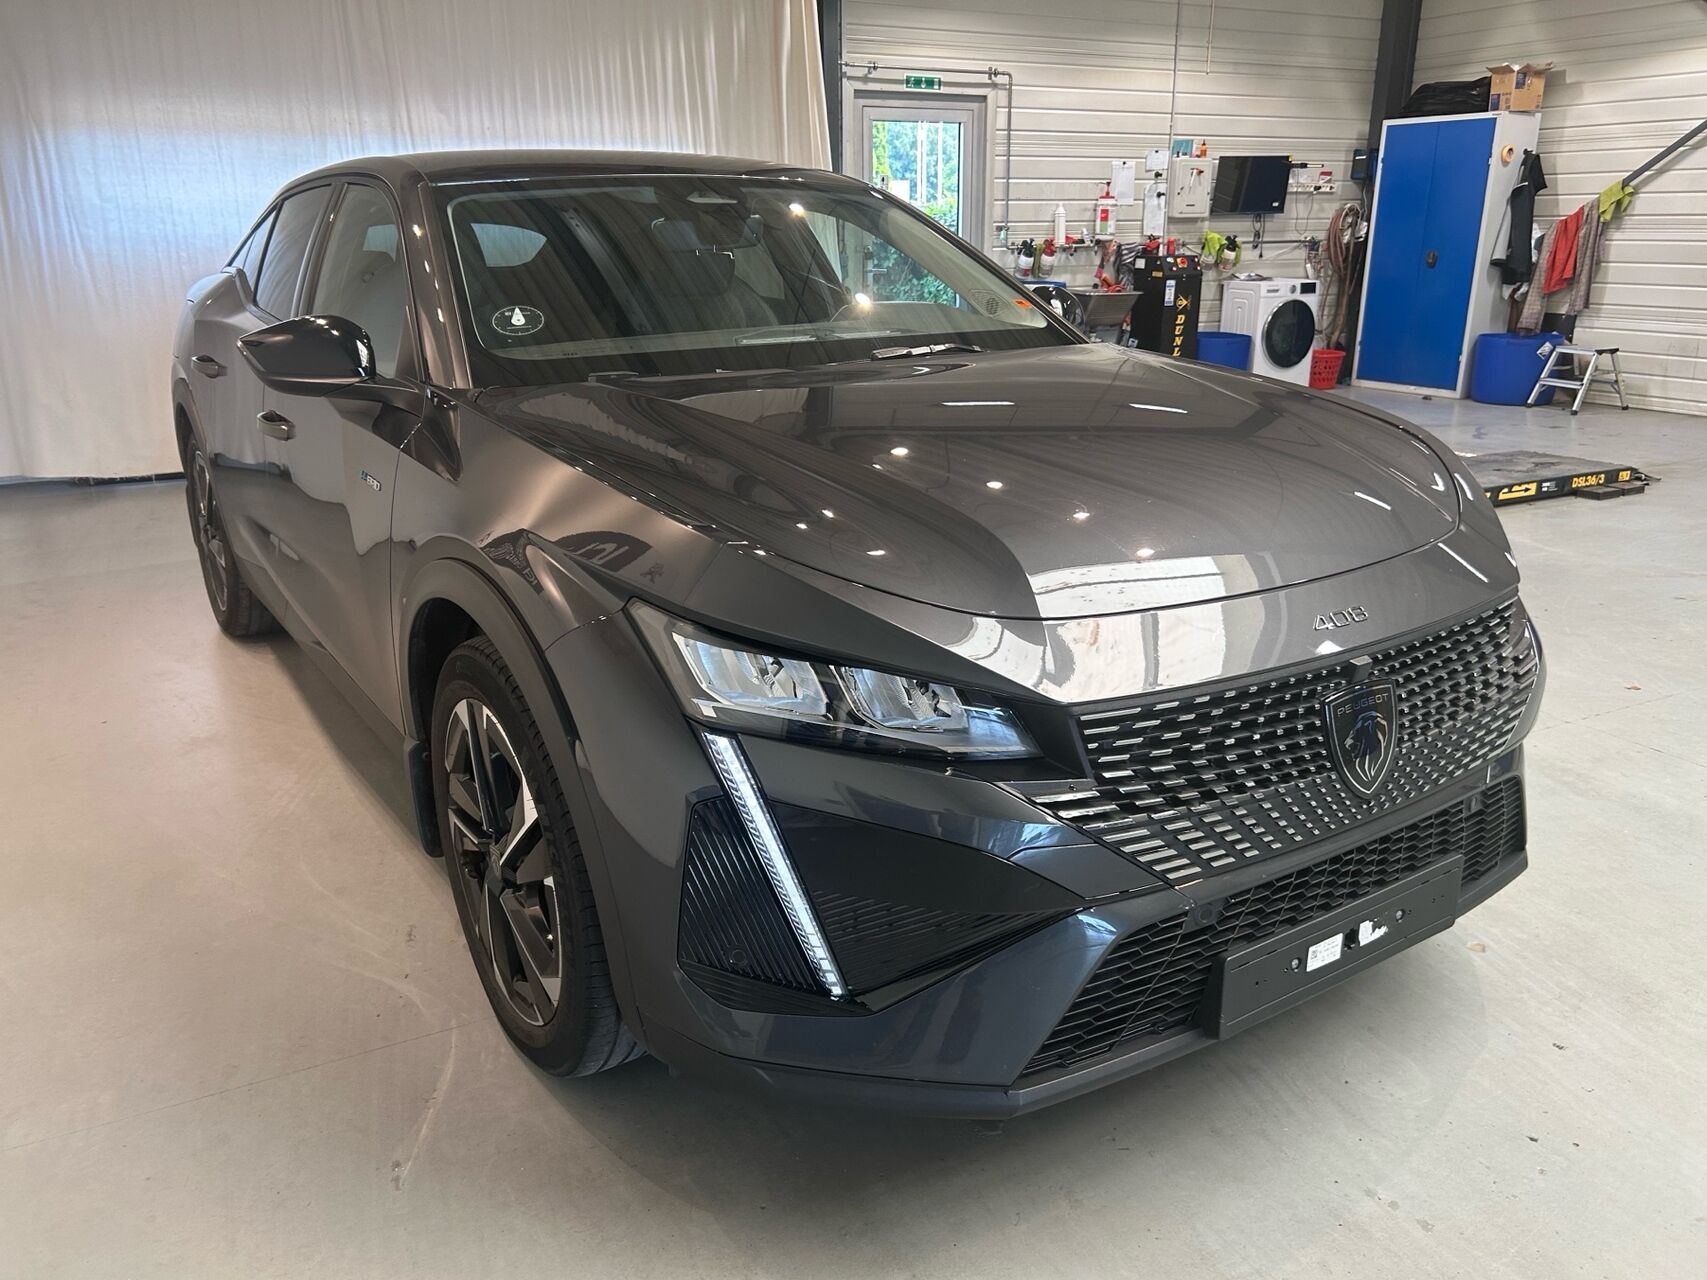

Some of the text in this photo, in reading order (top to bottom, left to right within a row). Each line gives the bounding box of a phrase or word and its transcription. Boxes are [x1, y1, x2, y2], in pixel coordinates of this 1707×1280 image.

[1571, 474, 1605, 488] DSL36/3
[1313, 606, 1368, 631] 408
[1337, 693, 1389, 715] PEUGEOT
